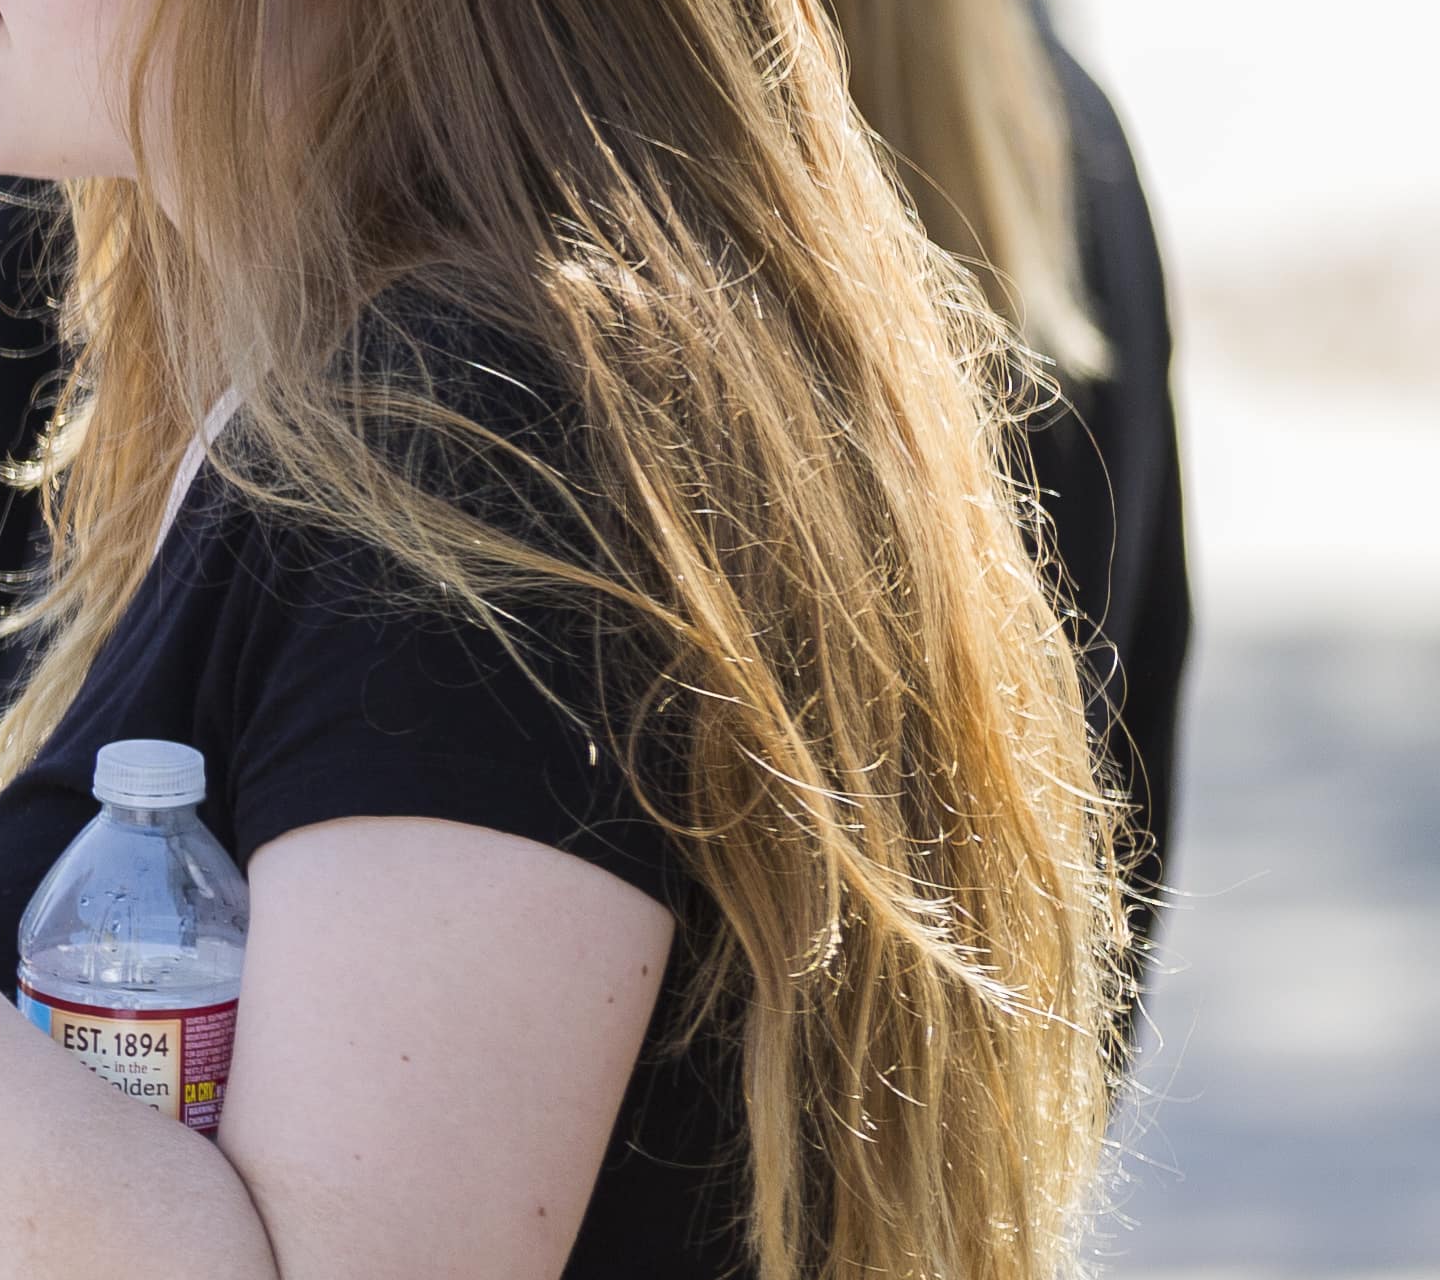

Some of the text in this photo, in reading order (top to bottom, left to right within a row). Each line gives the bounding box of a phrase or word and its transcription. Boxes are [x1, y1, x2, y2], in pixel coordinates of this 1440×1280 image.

[63, 1023, 169, 1058] EST. 1894
[114, 1061, 148, 1074] in the
[108, 1077, 169, 1096] olden
